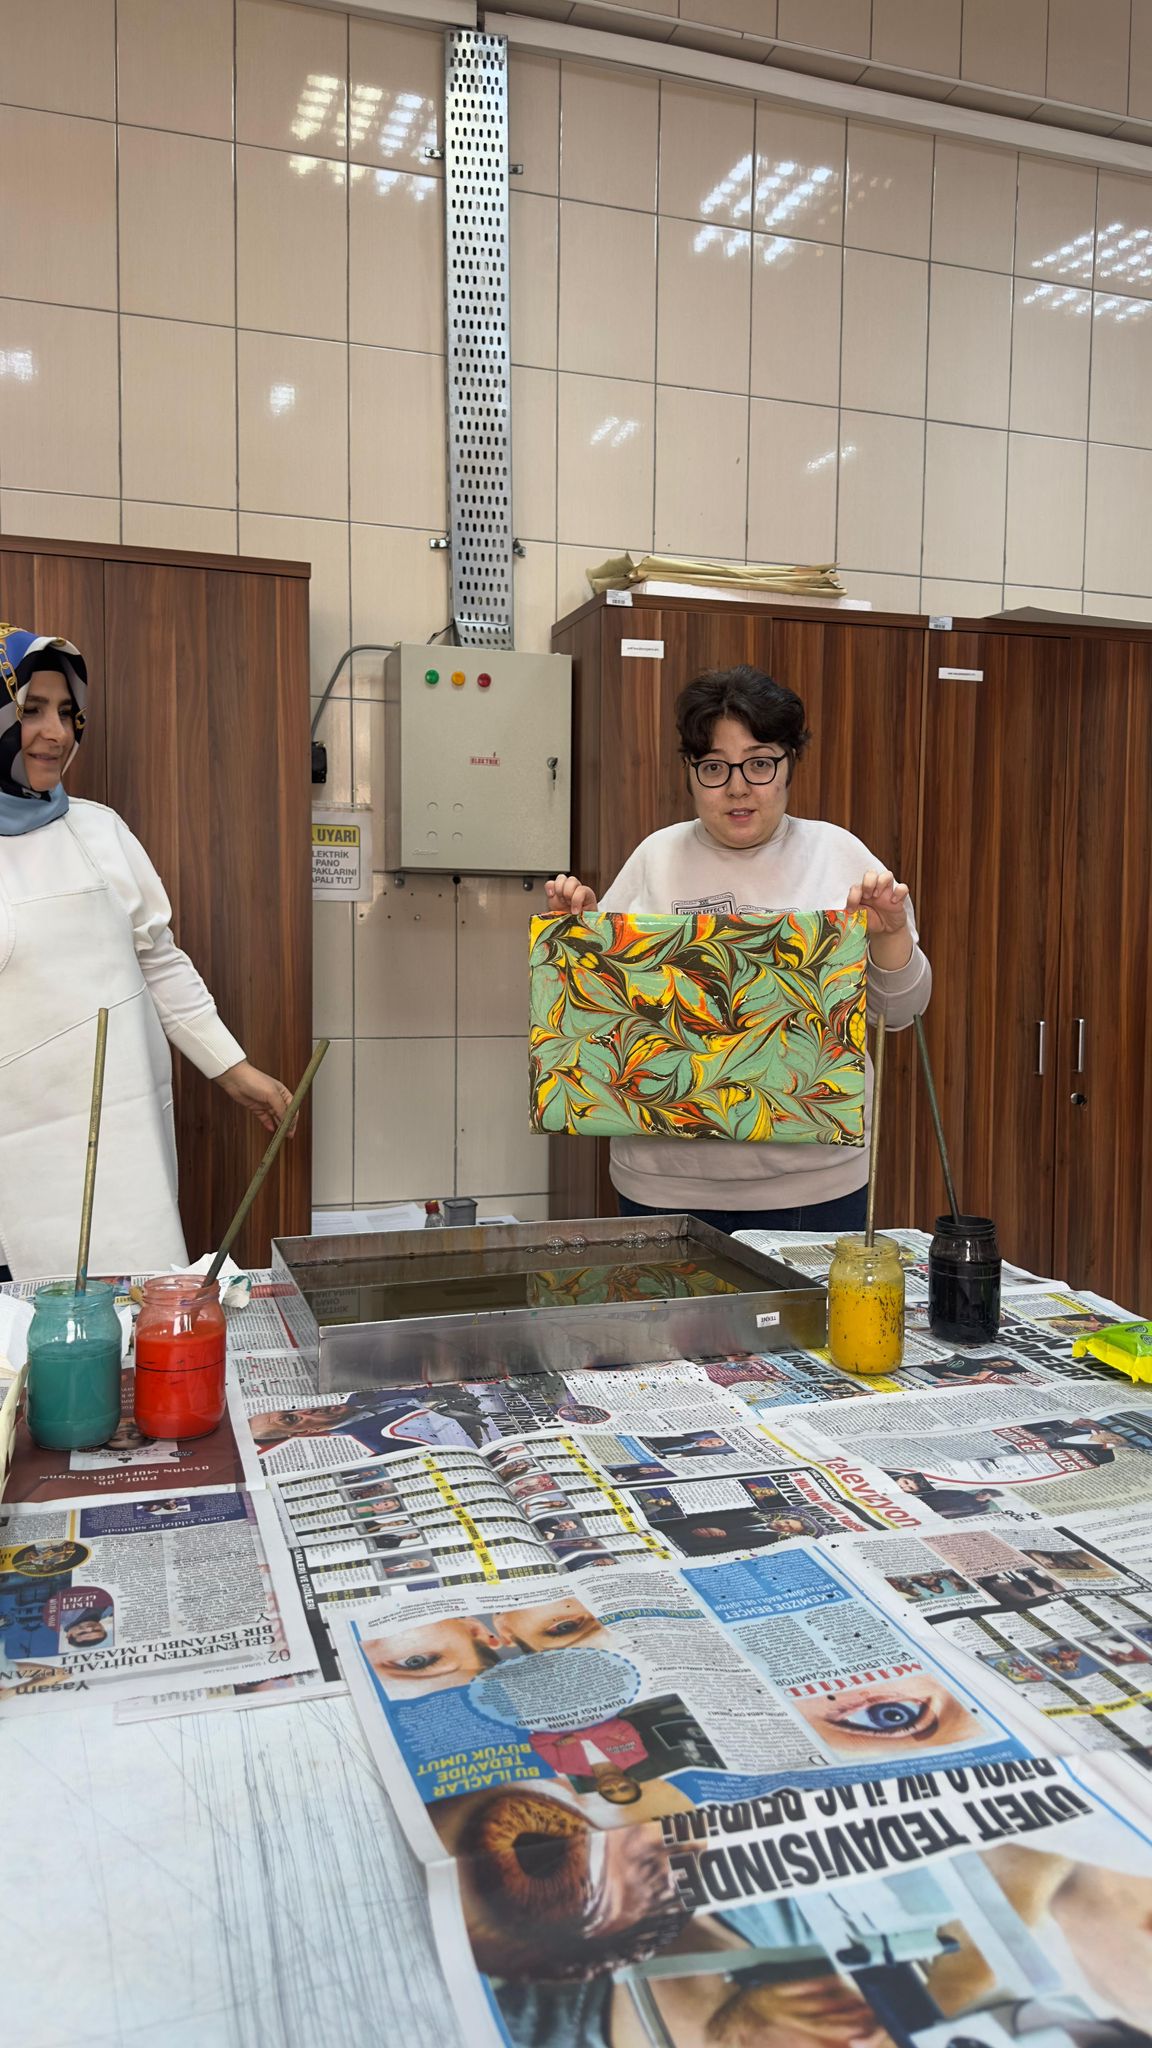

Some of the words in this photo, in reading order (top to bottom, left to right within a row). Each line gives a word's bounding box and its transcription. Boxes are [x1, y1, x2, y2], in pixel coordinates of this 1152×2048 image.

[317, 829, 356, 842] UYARI
[312, 850, 349, 858] LEKTRİK
[316, 859, 340, 867] PANO
[312, 868, 357, 876] PAKLARINI
[163, 1465, 209, 1473] OSMAN
[817, 1456, 922, 1527] Televizyon
[773, 1589, 845, 1612] ÜKEMİZDE
[723, 1602, 774, 1620] BEHÇET
[142, 1631, 237, 1653] İSTANBUL
[242, 1623, 273, 1642] BİR
[59, 1646, 137, 1666] MASALI
[153, 1634, 276, 1663] GELENEKTEN
[265, 1649, 291, 1664] 02
[62, 1654, 148, 1676] DİJİTALE
[840, 1651, 912, 1675] TESTLERDEN
[772, 1667, 841, 1688] KAÇAMIYOR
[15, 1679, 90, 1696] Yaşam
[580, 1697, 626, 1715] DÜNYASI
[515, 1710, 579, 1727] AYDINLANDI
[471, 1743, 532, 1762] BÜYÜK
[416, 1753, 468, 1777] UMUT
[437, 1753, 524, 1783] TEDAVİDE
[515, 1766, 540, 1778] BU
[433, 1769, 511, 1797] İLAÇLAR
[962, 1785, 1094, 1842] ÜVEİT
[668, 1807, 971, 1909] TEDAVİSİNDE
